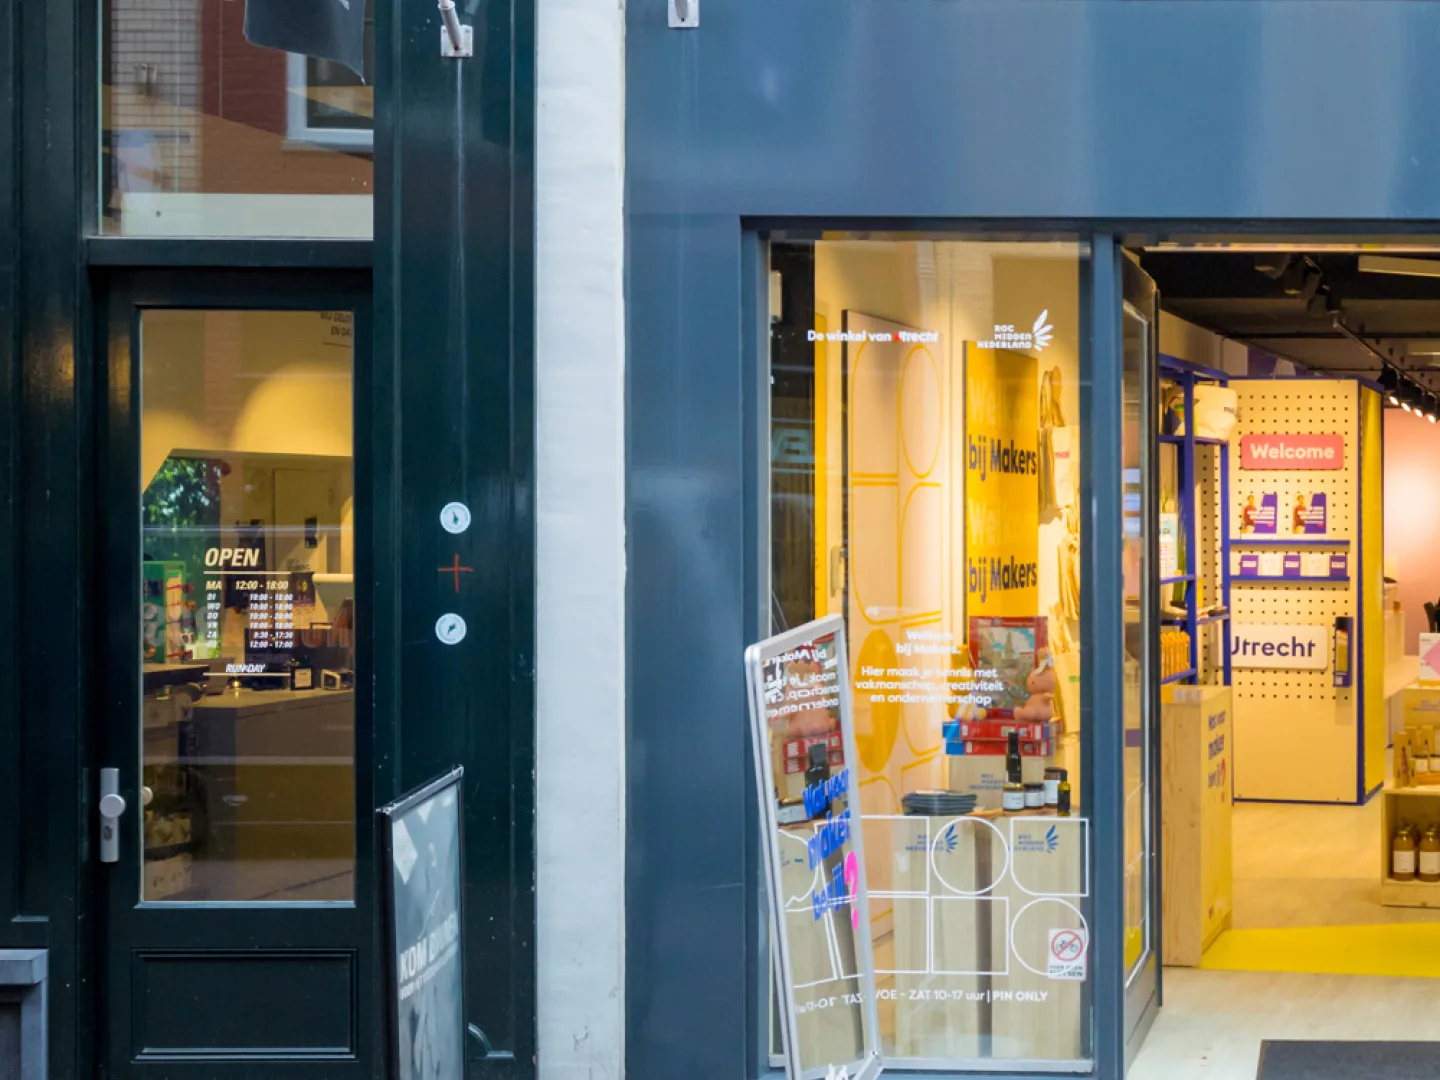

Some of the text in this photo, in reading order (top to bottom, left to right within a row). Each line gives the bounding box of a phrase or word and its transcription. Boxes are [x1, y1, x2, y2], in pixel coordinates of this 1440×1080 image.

[807, 330, 824, 342] De
[826, 330, 866, 342] winkel
[869, 334, 892, 342] van
[968, 434, 1037, 481] bij Makers
[1250, 442, 1335, 460] Welcome
[205, 547, 260, 567] OPEN
[206, 580, 223, 590] MA
[968, 555, 1037, 603] bij Makers
[906, 630, 954, 640] Welkom
[895, 643, 911, 656] bij
[861, 665, 998, 679] Hier maak je kennis met
[870, 693, 992, 706] en ondernemerschap
[803, 768, 849, 819] Wat voor
[807, 808, 851, 871] maker
[400, 936, 427, 984] KOM
[908, 989, 931, 1000] ZAT
[933, 989, 963, 1001] 10-17
[965, 992, 985, 1001] uur
[992, 989, 1013, 1001] PIN
[1016, 989, 1048, 1001] ONLY
